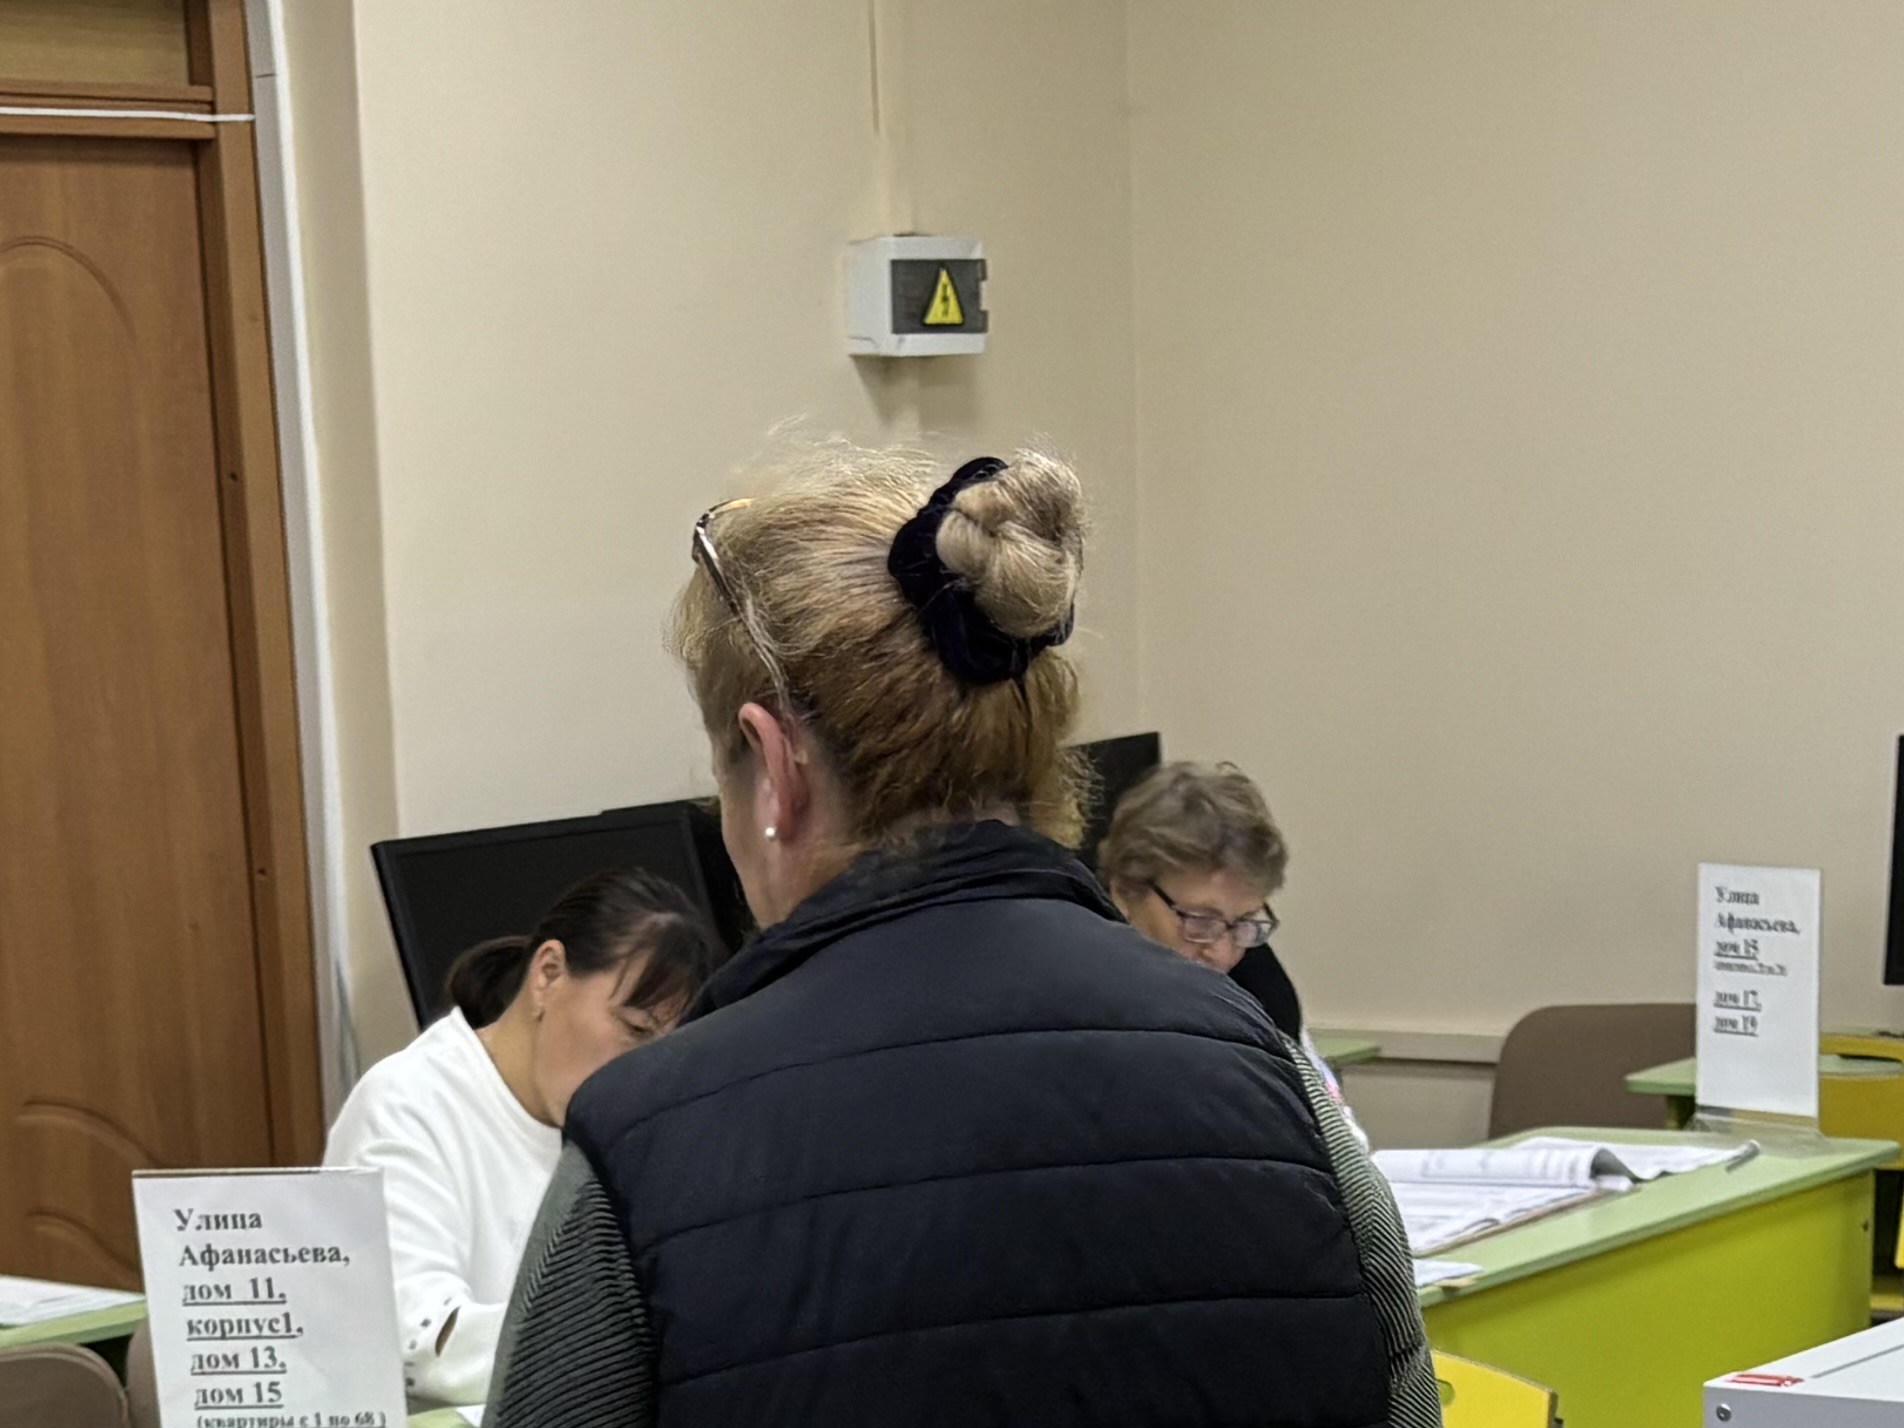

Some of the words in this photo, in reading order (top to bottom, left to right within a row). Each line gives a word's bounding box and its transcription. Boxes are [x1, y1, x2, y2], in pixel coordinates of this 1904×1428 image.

[173, 1207, 264, 1232] Улица
[178, 1242, 351, 1273] Афанасьева,
[182, 1282, 233, 1303] дом
[191, 1352, 240, 1373] дом
[195, 1387, 244, 1407] дом
[254, 1380, 283, 1404] 15
